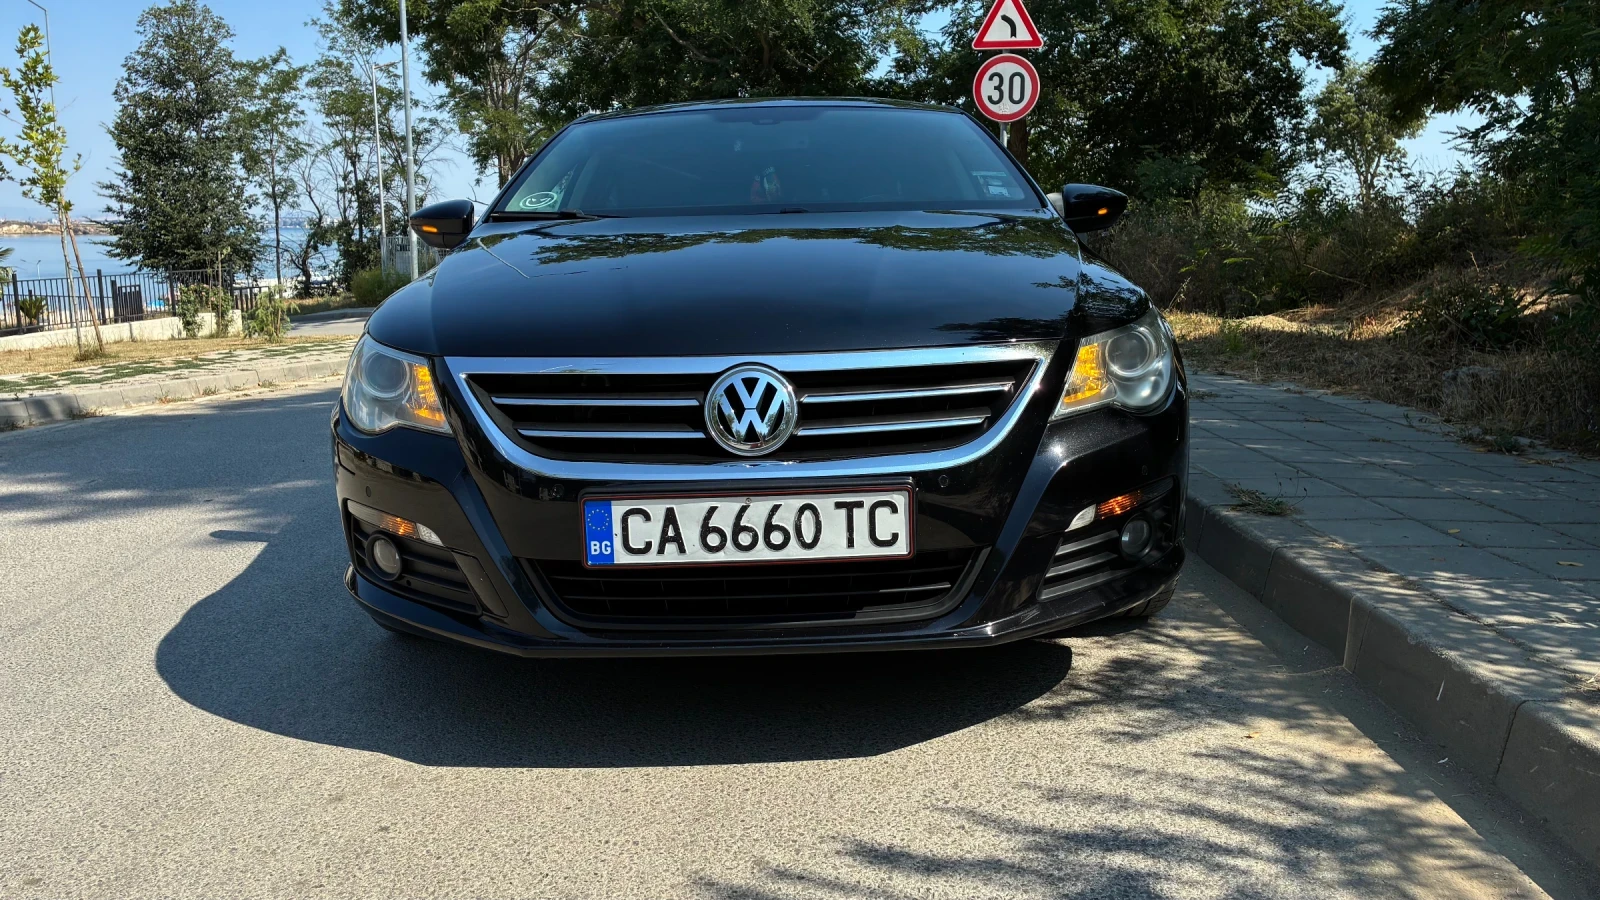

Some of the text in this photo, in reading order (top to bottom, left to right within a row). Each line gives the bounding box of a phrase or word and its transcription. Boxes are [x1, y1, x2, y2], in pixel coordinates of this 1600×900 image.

[987, 71, 1026, 105] 30
[710, 370, 790, 449] VW
[590, 541, 612, 555] BG
[620, 499, 899, 555] CA 6660 TC
